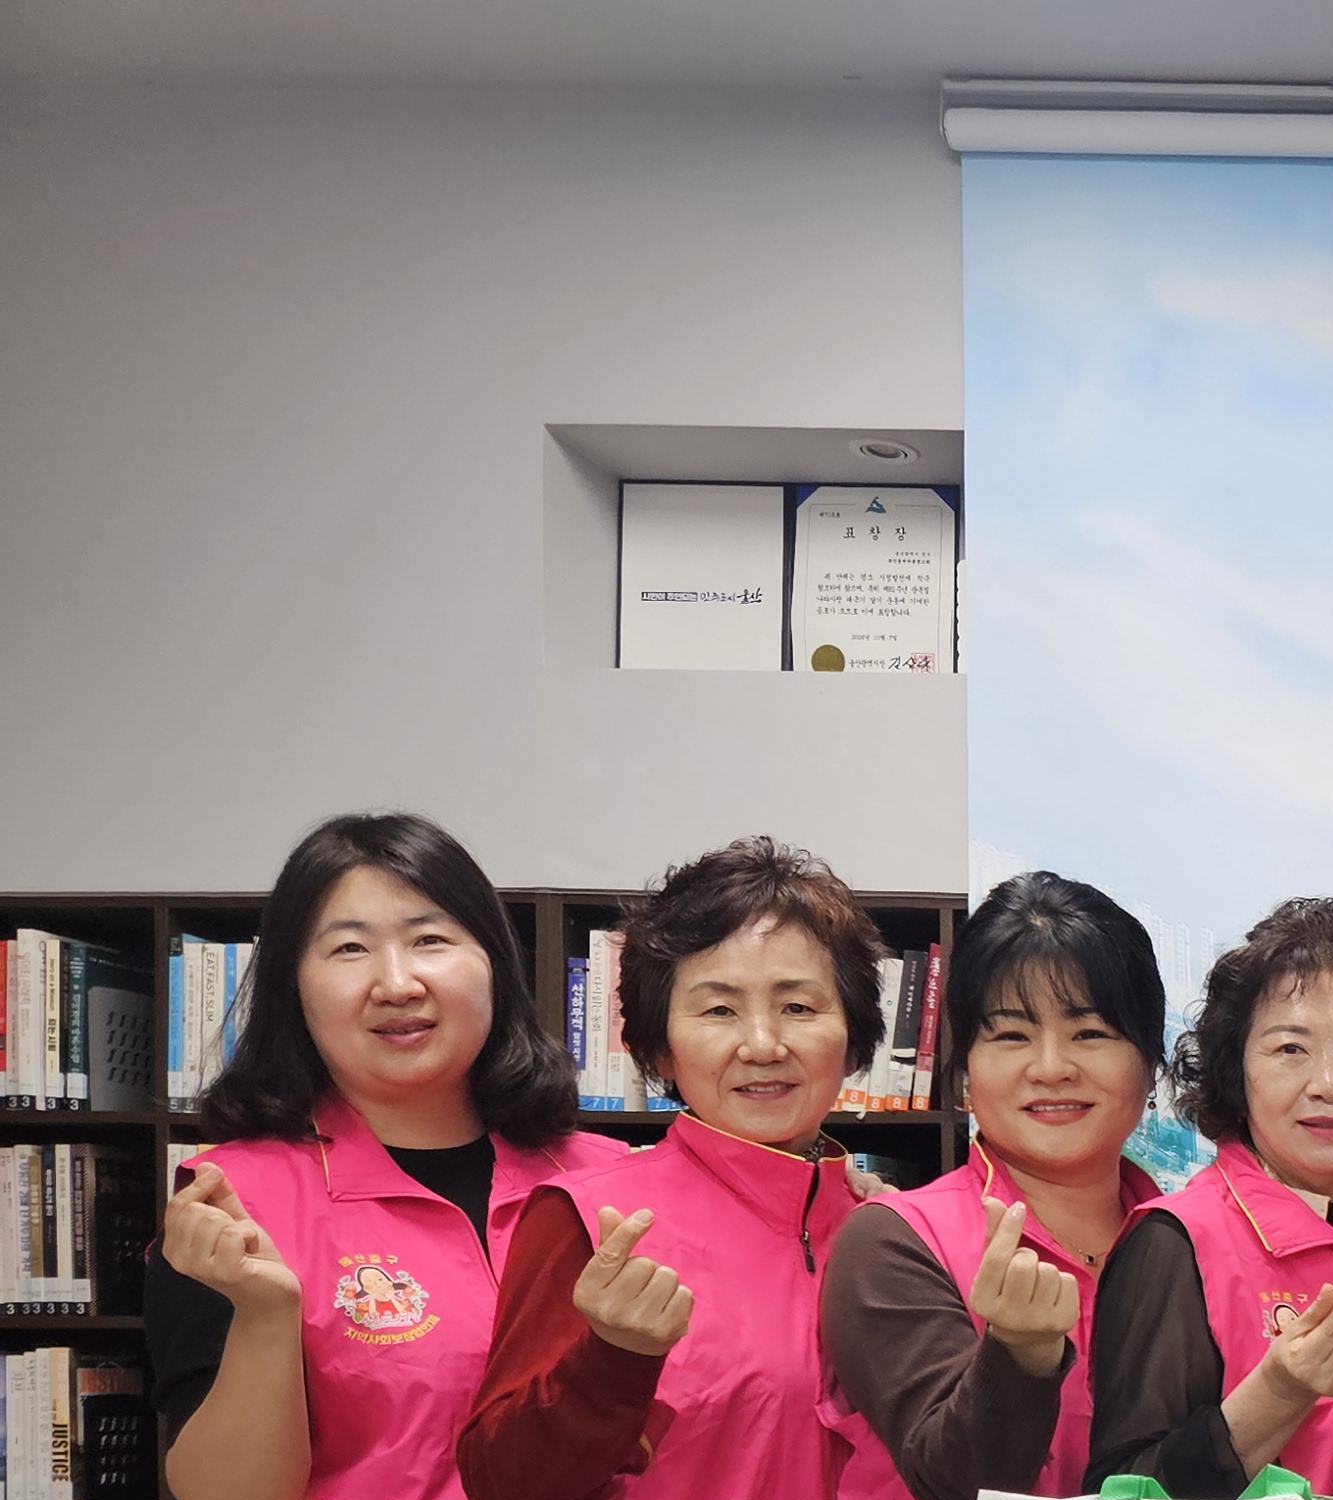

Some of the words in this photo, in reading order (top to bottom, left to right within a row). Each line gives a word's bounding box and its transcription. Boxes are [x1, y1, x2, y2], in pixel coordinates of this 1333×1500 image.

[21, 1096, 30, 1107] 3
[849, 1091, 859, 1102] 8
[47, 1098, 56, 1109] 3
[70, 1099, 79, 1110] 3
[593, 1098, 601, 1110] 7
[611, 1098, 620, 1110] 7
[916, 1097, 925, 1109] 8
[7, 1304, 15, 1315] 3
[76, 1304, 85, 1314] 3
[52, 1423, 69, 1483] JUSTICE
